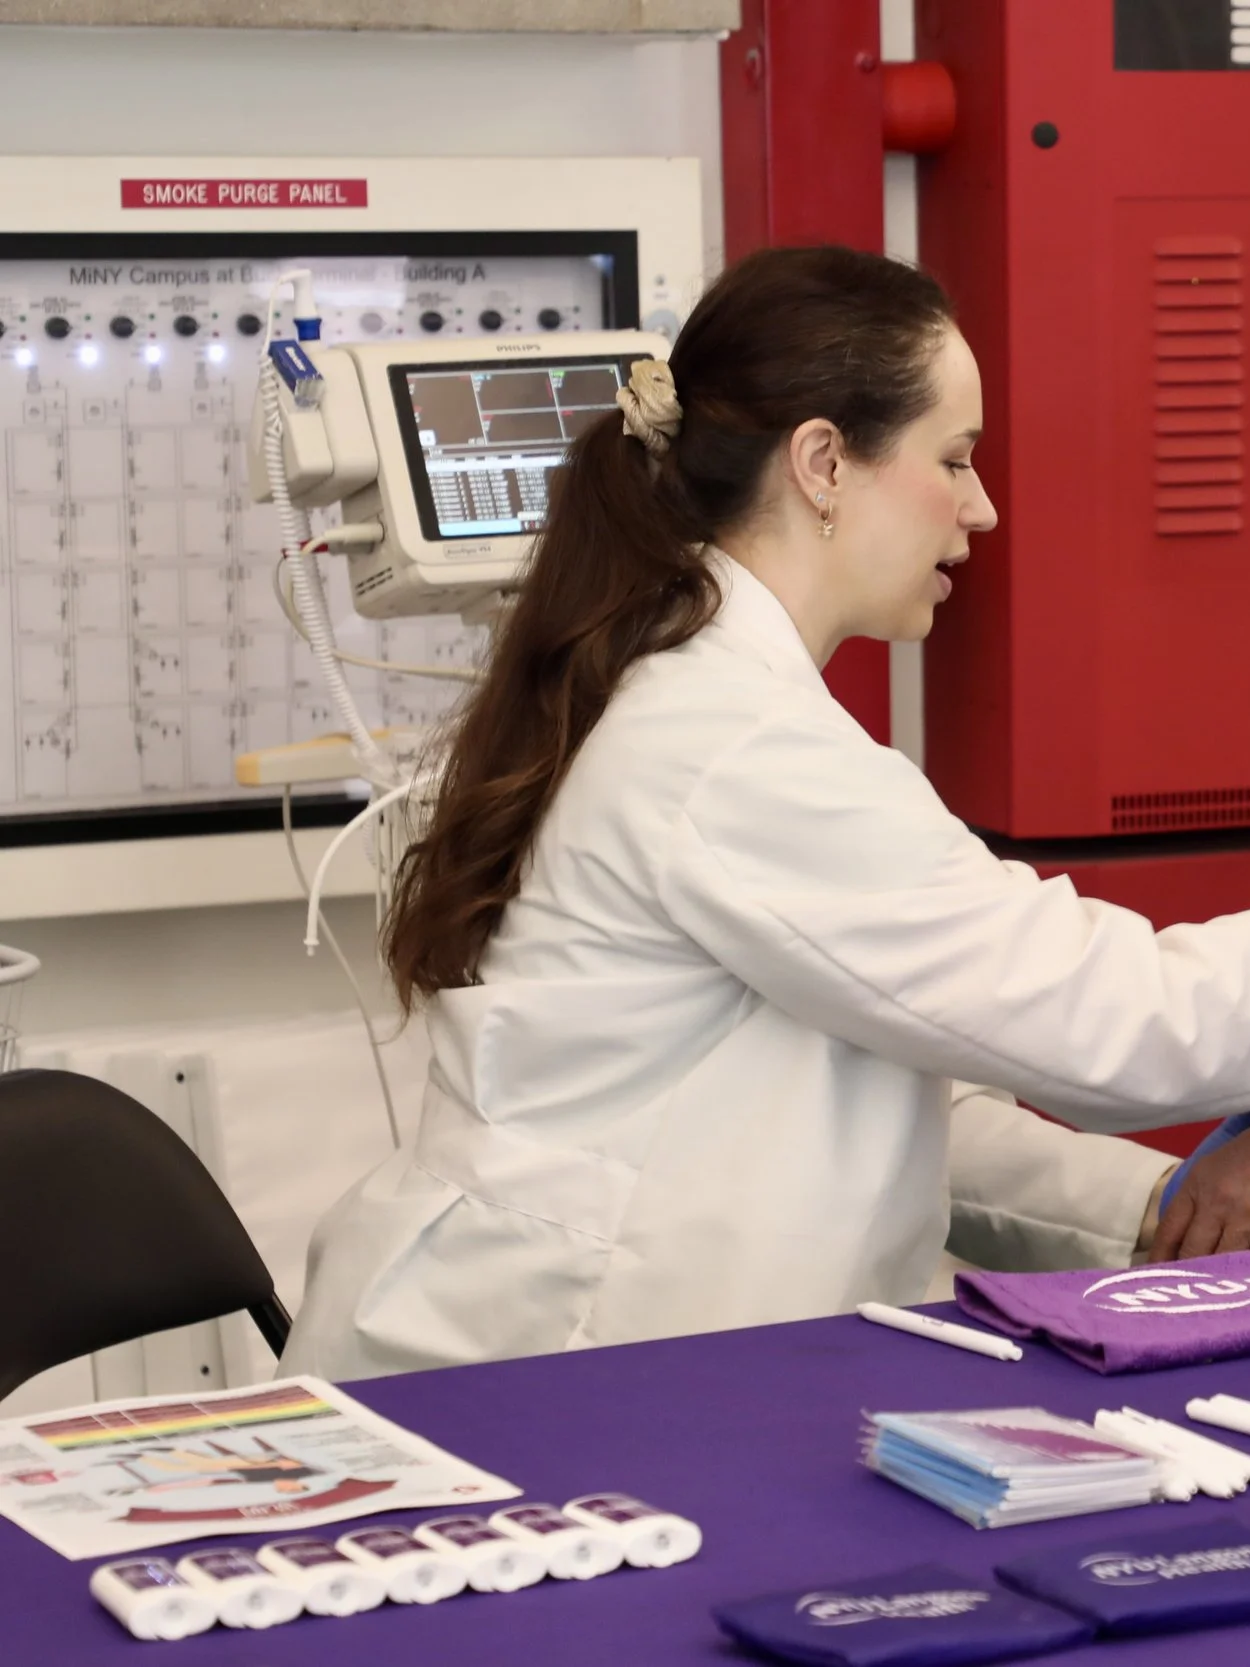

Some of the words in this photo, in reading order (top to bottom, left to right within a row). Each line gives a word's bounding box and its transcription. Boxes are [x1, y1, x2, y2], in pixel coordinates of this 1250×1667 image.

[143, 183, 208, 205] SMOKE
[218, 183, 279, 204] PURGE
[289, 182, 347, 204] PANEL
[69, 266, 123, 285] MiNY
[129, 265, 211, 286] Campus
[216, 266, 234, 284] at
[395, 263, 466, 284] Building
[472, 263, 486, 282] A
[1110, 1278, 1248, 1305] NYU
